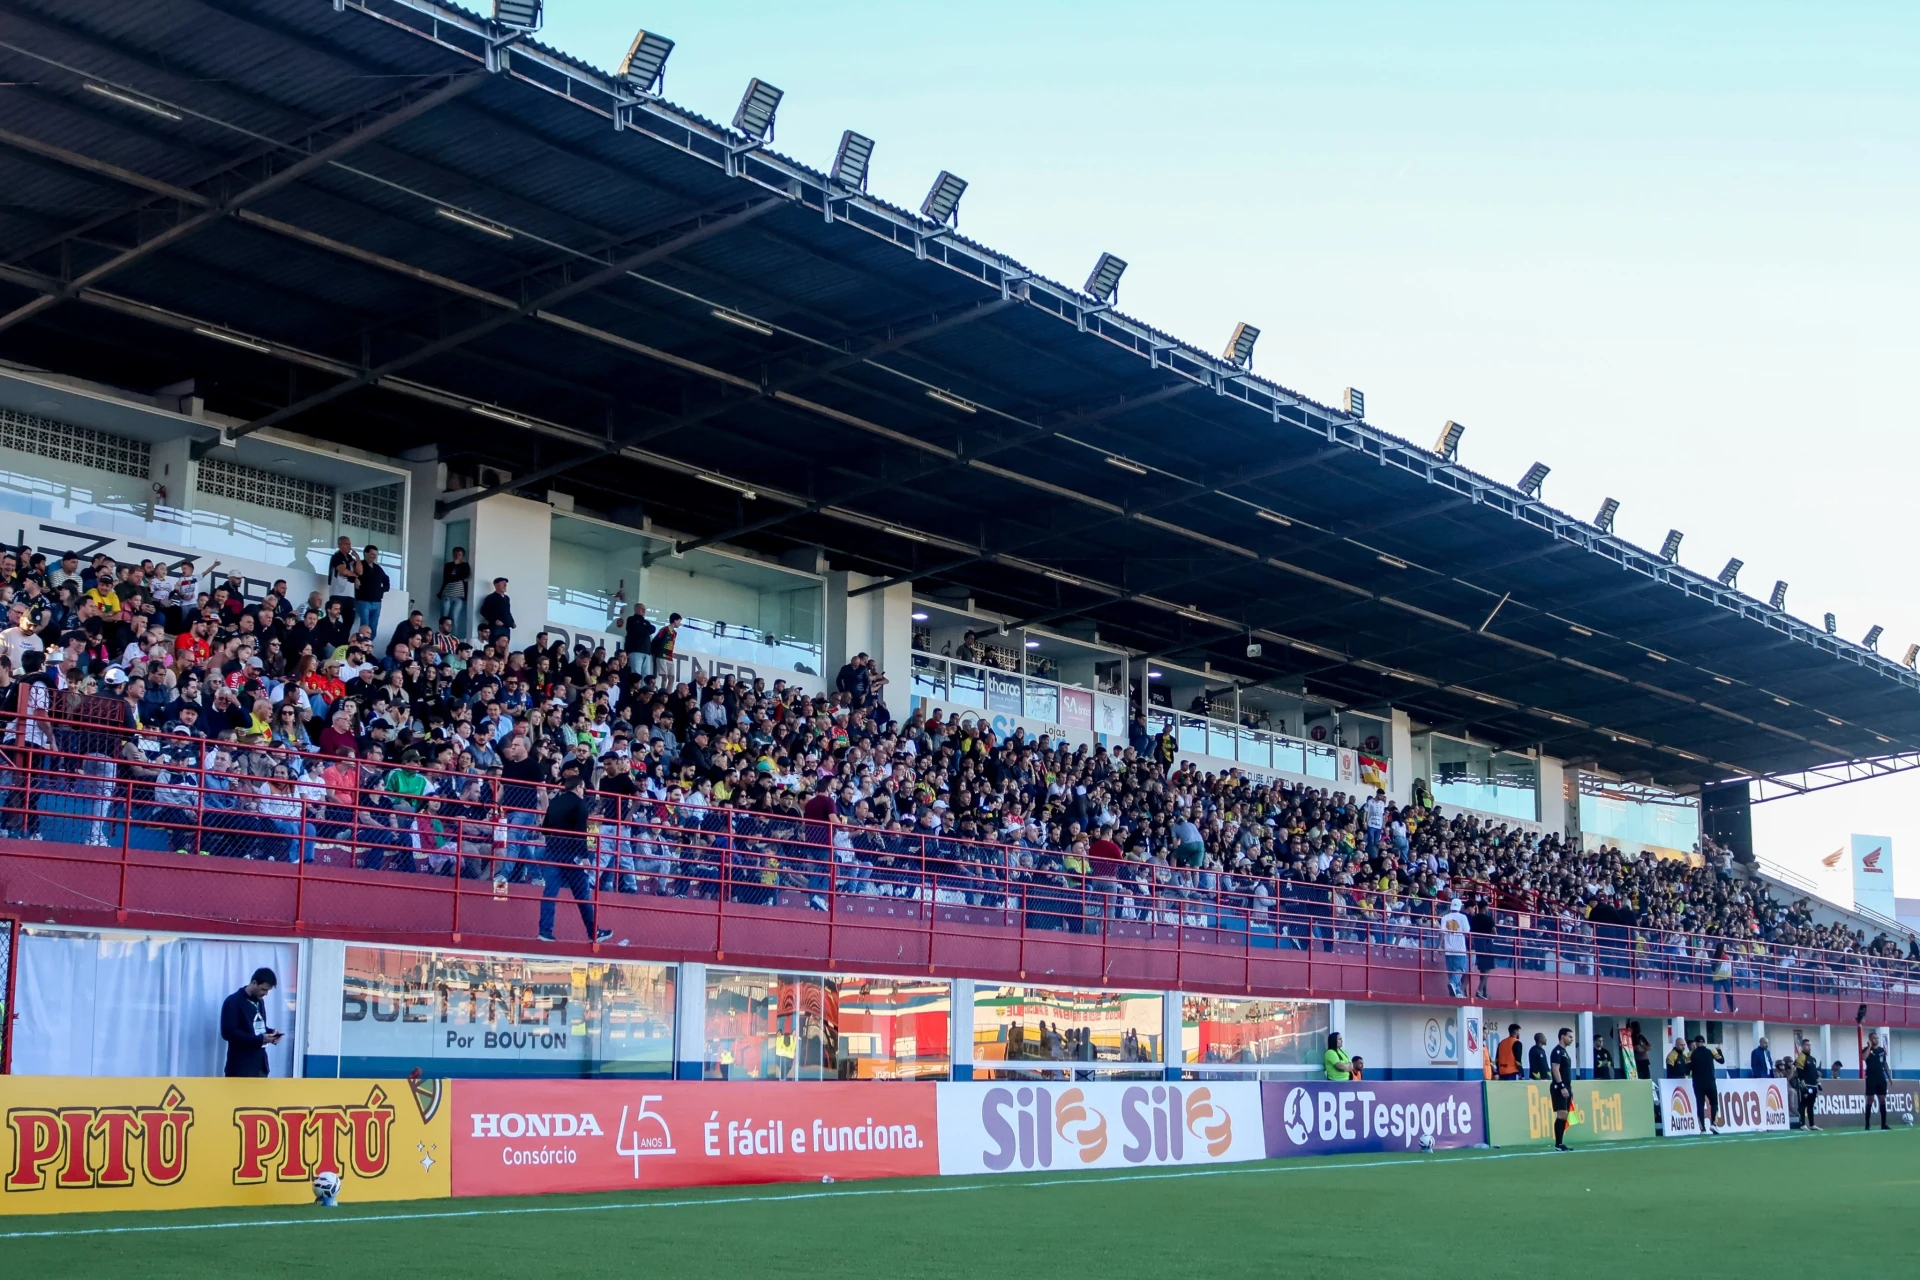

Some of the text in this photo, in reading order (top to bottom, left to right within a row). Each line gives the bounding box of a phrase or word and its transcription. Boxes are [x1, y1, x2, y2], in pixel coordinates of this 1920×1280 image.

[1044, 723, 1066, 741] Lojas
[1247, 771, 1264, 784] CLUBE
[446, 1030, 567, 1050] Por BOUTON
[1813, 1089, 1913, 1115] BRASILEIRO ÉRIE C
[470, 1112, 604, 1138] HONDA
[1671, 1115, 1695, 1131] Aurora
[1766, 1110, 1786, 1126] Aurora
[5, 1084, 195, 1192] PITÚ
[232, 1084, 395, 1186] PITÚ
[704, 1110, 924, 1156] É fácil e funciona.
[640, 1138, 663, 1148] ANOS
[502, 1146, 577, 1165] Consórcio
